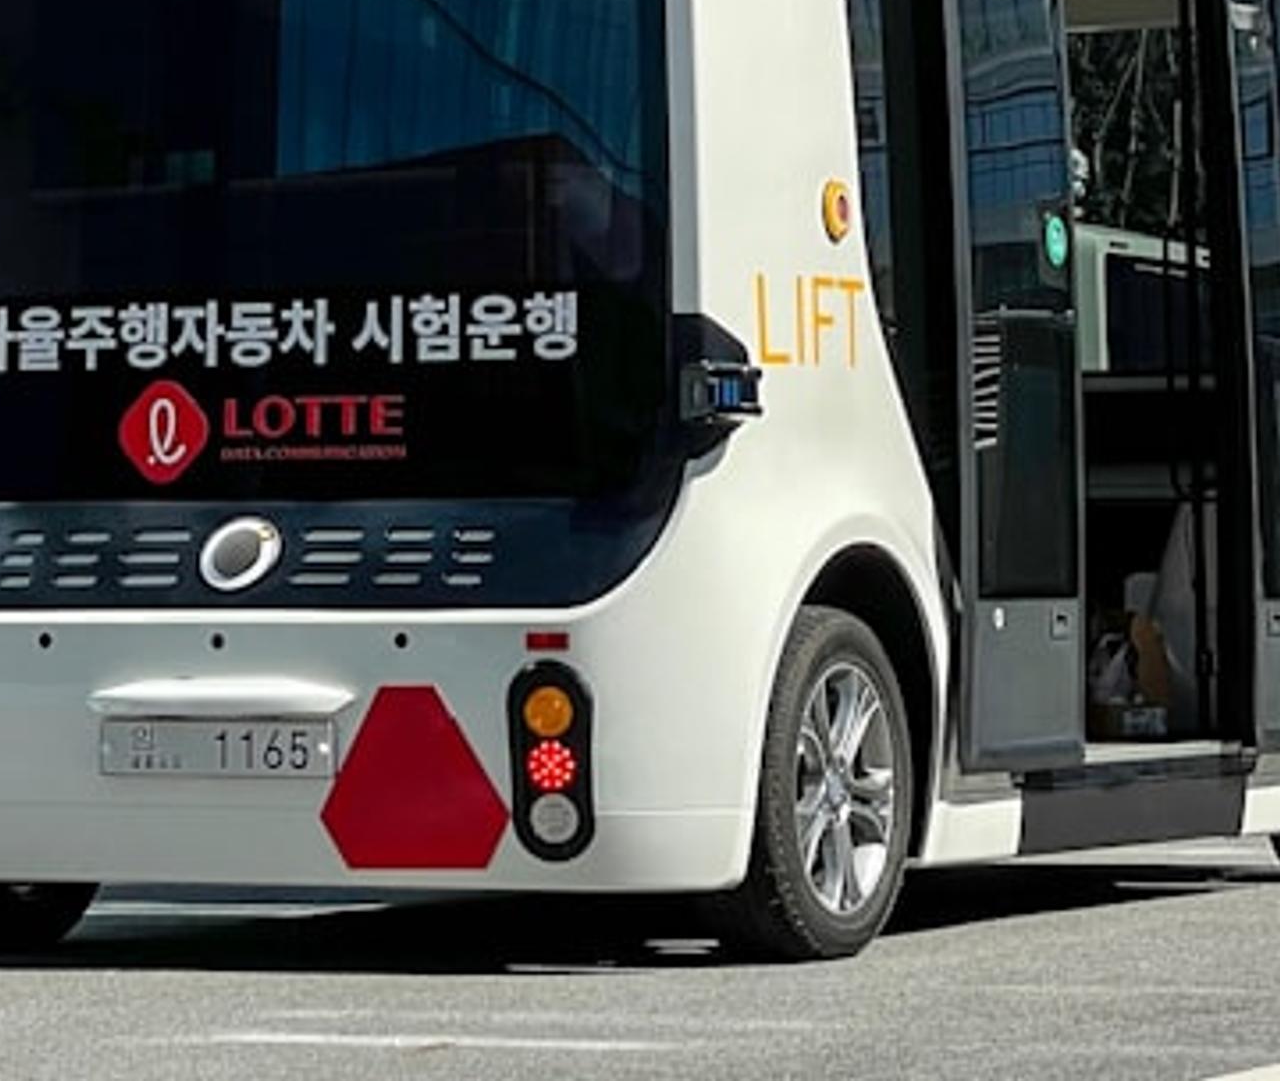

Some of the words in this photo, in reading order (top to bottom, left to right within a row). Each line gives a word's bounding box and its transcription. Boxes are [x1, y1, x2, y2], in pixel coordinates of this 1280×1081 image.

[353, 291, 579, 364] 시험운행
[756, 273, 865, 368] LIFT
[223, 394, 405, 437] LOTTE
[214, 728, 308, 770] 1165
